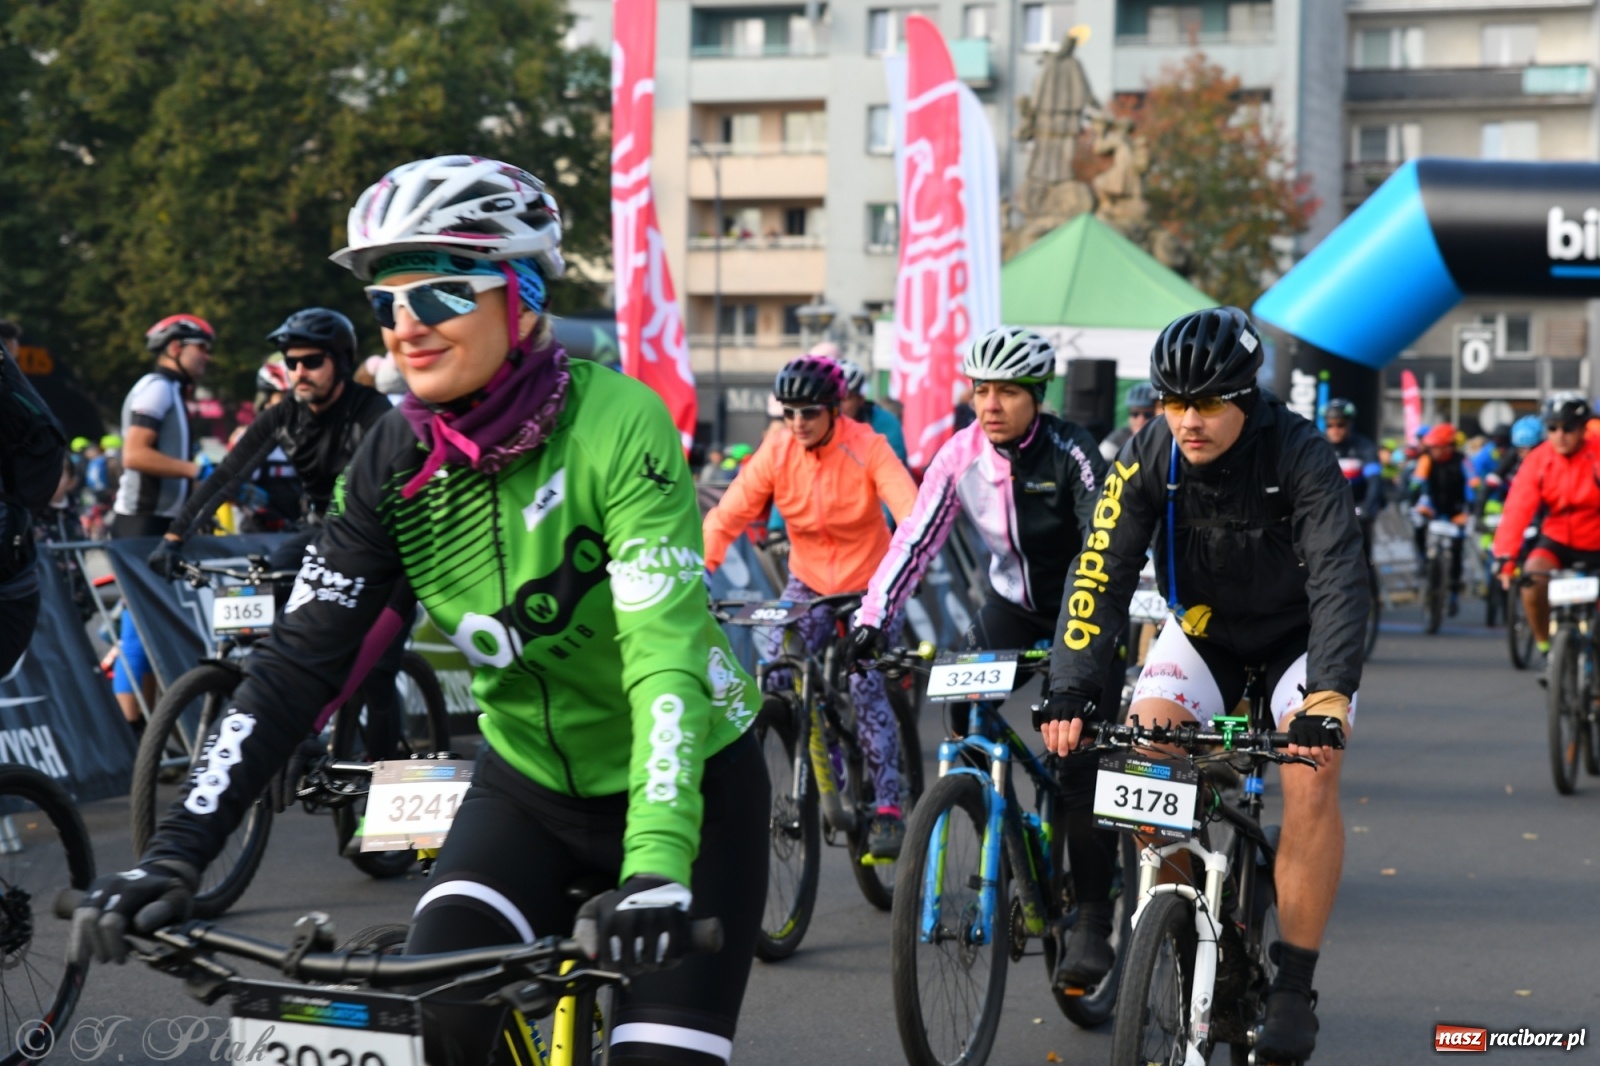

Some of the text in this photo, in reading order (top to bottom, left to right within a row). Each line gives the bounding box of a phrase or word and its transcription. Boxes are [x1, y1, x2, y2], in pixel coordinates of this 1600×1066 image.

[1547, 205, 1600, 261] bi
[727, 388, 771, 412] MA
[223, 602, 264, 621] 3165
[946, 669, 1002, 687] 3243
[389, 793, 459, 822] 3241
[1113, 784, 1179, 816] 3178
